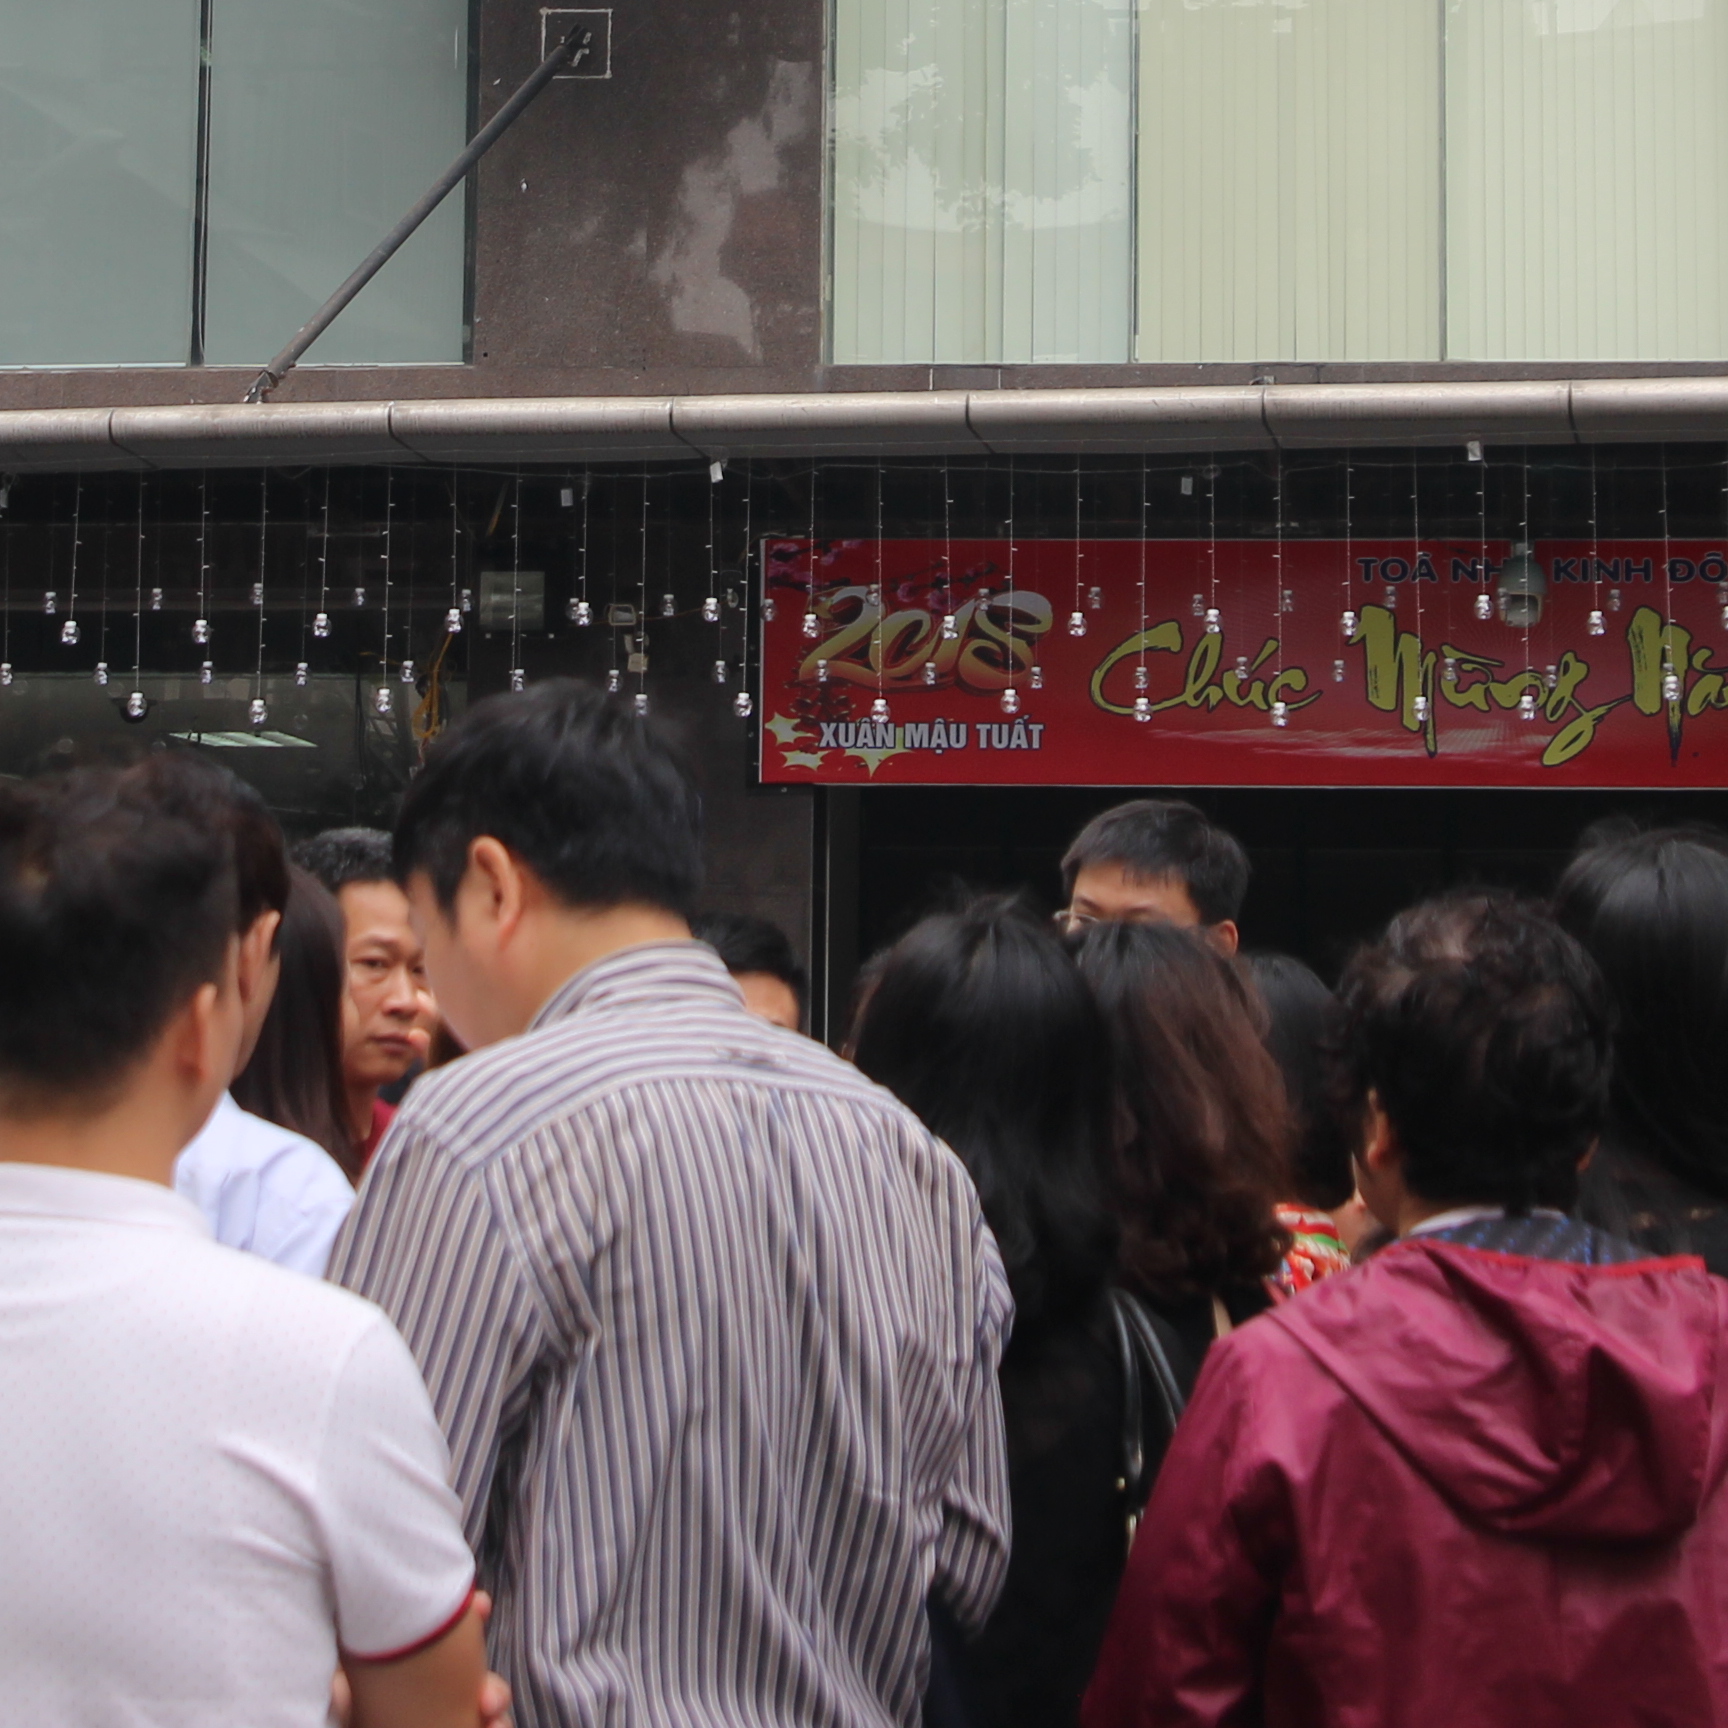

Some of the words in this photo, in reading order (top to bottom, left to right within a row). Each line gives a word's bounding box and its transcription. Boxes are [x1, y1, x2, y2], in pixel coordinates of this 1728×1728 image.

[1451, 557, 1506, 583] NH
[1553, 558, 1653, 583] KINH
[1668, 552, 1728, 582] ĐÔ
[799, 585, 1053, 695] 2018
[1090, 620, 1323, 716] Chúc
[819, 717, 896, 749] XUÂN
[903, 717, 968, 754] MẬU
[975, 714, 1044, 749] TUẤT
